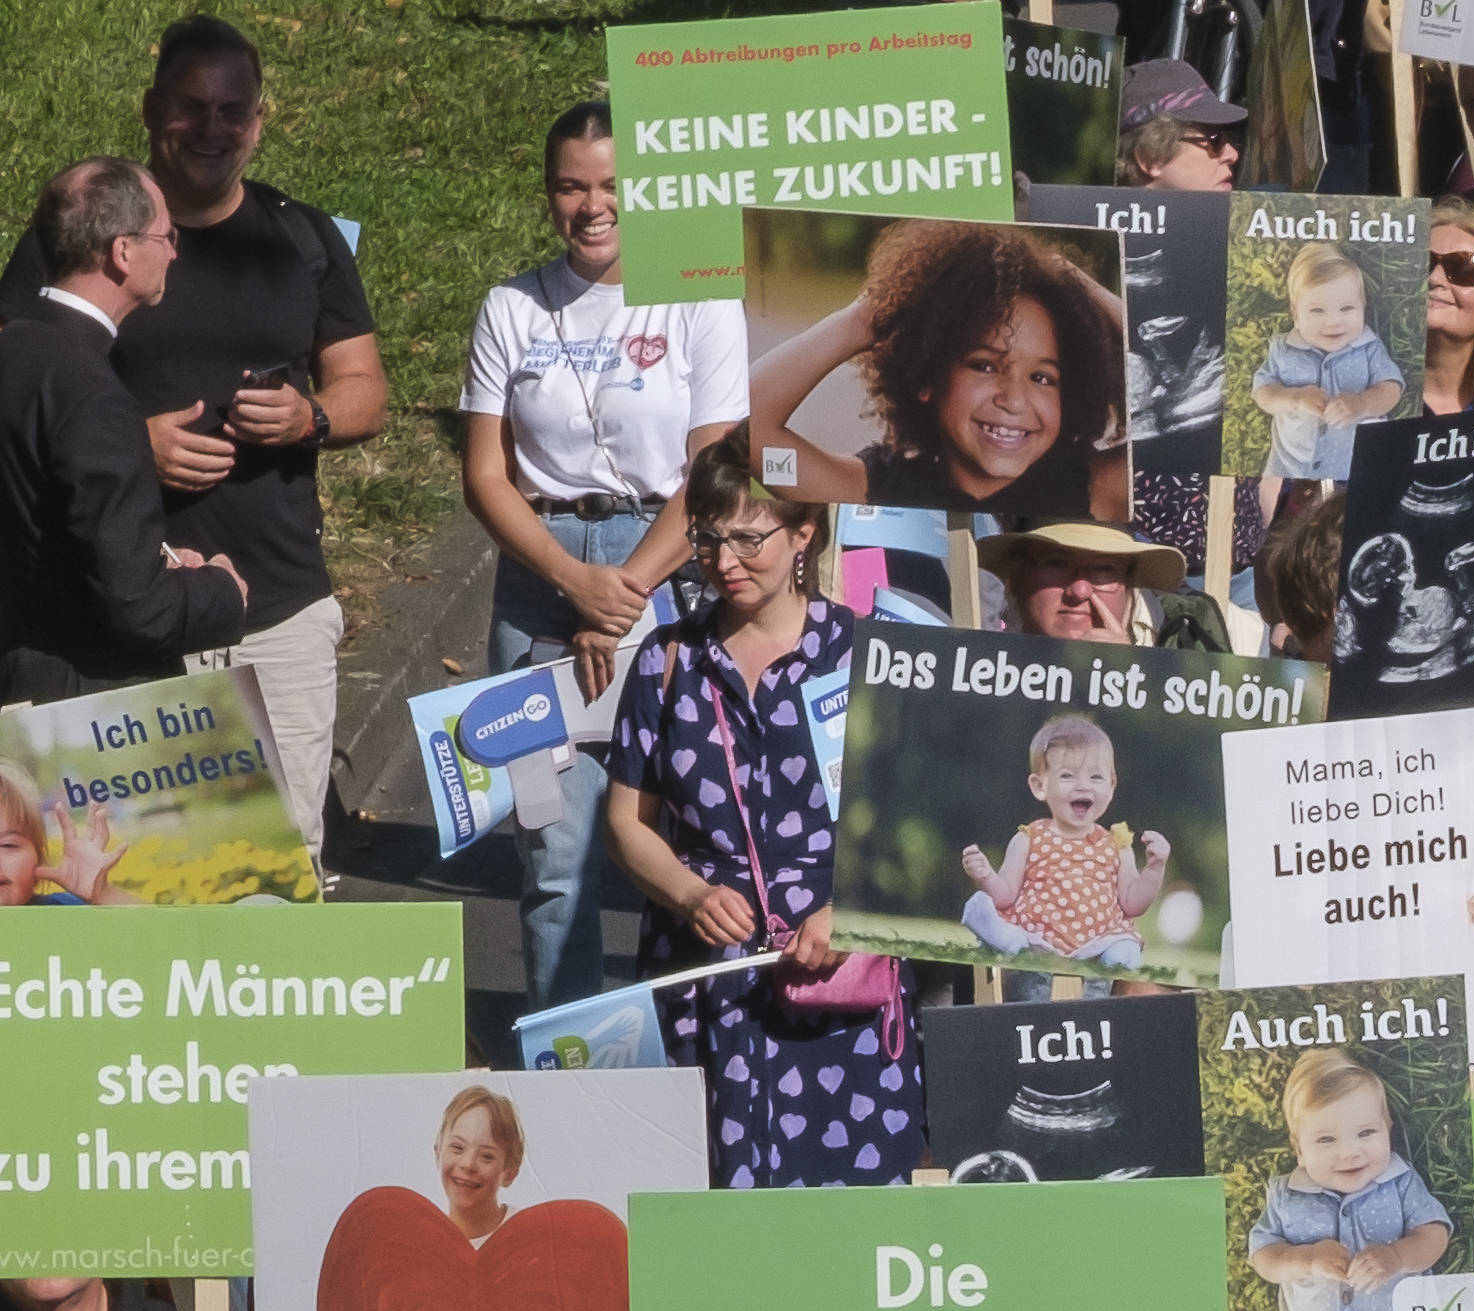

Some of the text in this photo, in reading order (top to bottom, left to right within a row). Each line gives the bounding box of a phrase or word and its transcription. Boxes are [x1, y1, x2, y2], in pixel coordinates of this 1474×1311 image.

[636, 30, 972, 67] 400 Abtreibungen pro Arbeitstag
[1025, 48, 1112, 89] schön!
[635, 100, 958, 155] KEINE KINDER
[623, 151, 1002, 212] KEINE ZUKUNFT!
[865, 638, 1304, 725] Das Leben ist schön!
[90, 703, 216, 754] Ich bin
[473, 706, 525, 743] CITIZEN
[62, 739, 270, 809] besonders!
[1285, 747, 1436, 786] Mama, ich
[1290, 787, 1445, 823] liebe Dich!
[1273, 829, 1468, 878] Liebe mich
[1323, 884, 1420, 925] auch!
[1016, 1019, 1112, 1064] Ich!
[1222, 998, 1450, 1052] Auch ich!
[876, 1243, 988, 1309] Die
